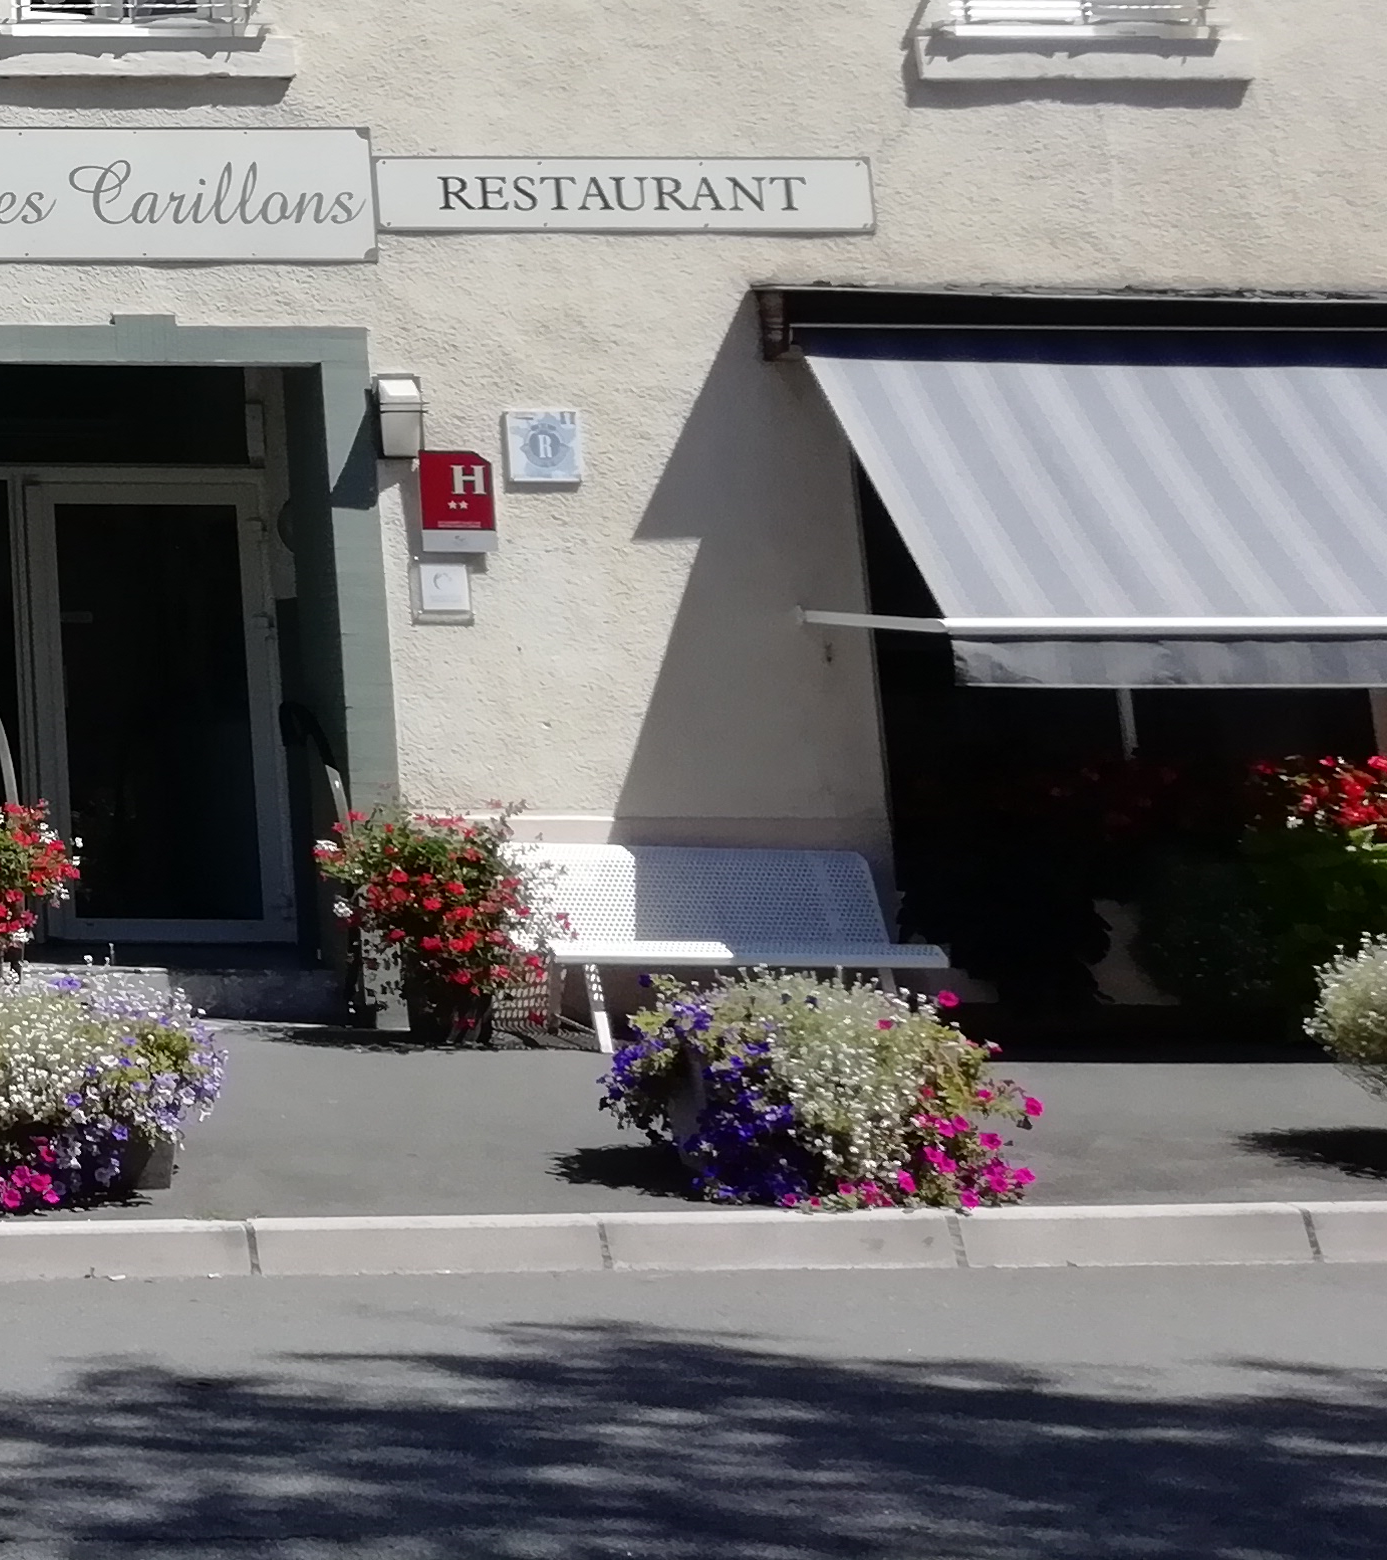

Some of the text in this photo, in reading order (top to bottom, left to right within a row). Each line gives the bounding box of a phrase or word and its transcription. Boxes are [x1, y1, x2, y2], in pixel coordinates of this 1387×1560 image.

[68, 159, 367, 226] Carillons
[436, 175, 807, 212] RESTAURANT
[449, 464, 487, 495] H
